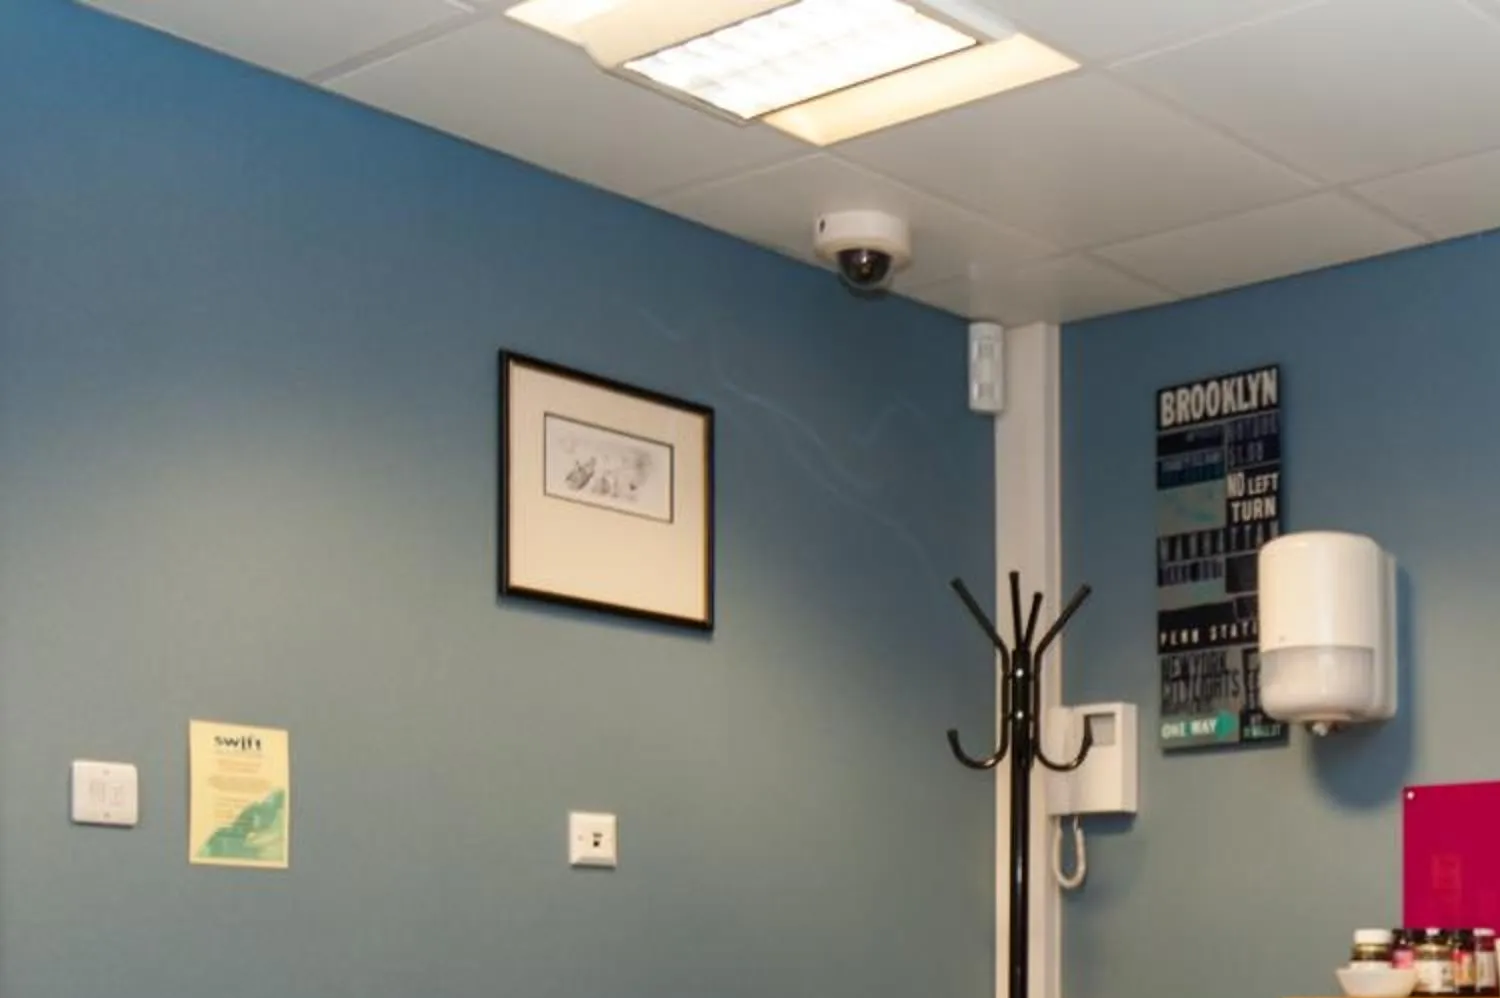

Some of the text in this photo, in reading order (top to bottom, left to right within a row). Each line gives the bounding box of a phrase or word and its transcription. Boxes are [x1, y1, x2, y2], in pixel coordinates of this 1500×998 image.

[1159, 367, 1278, 428] BROOKLYN
[1226, 472, 1279, 498] NO LEFT
[1231, 495, 1276, 523] TURN
[213, 734, 262, 750] swift
